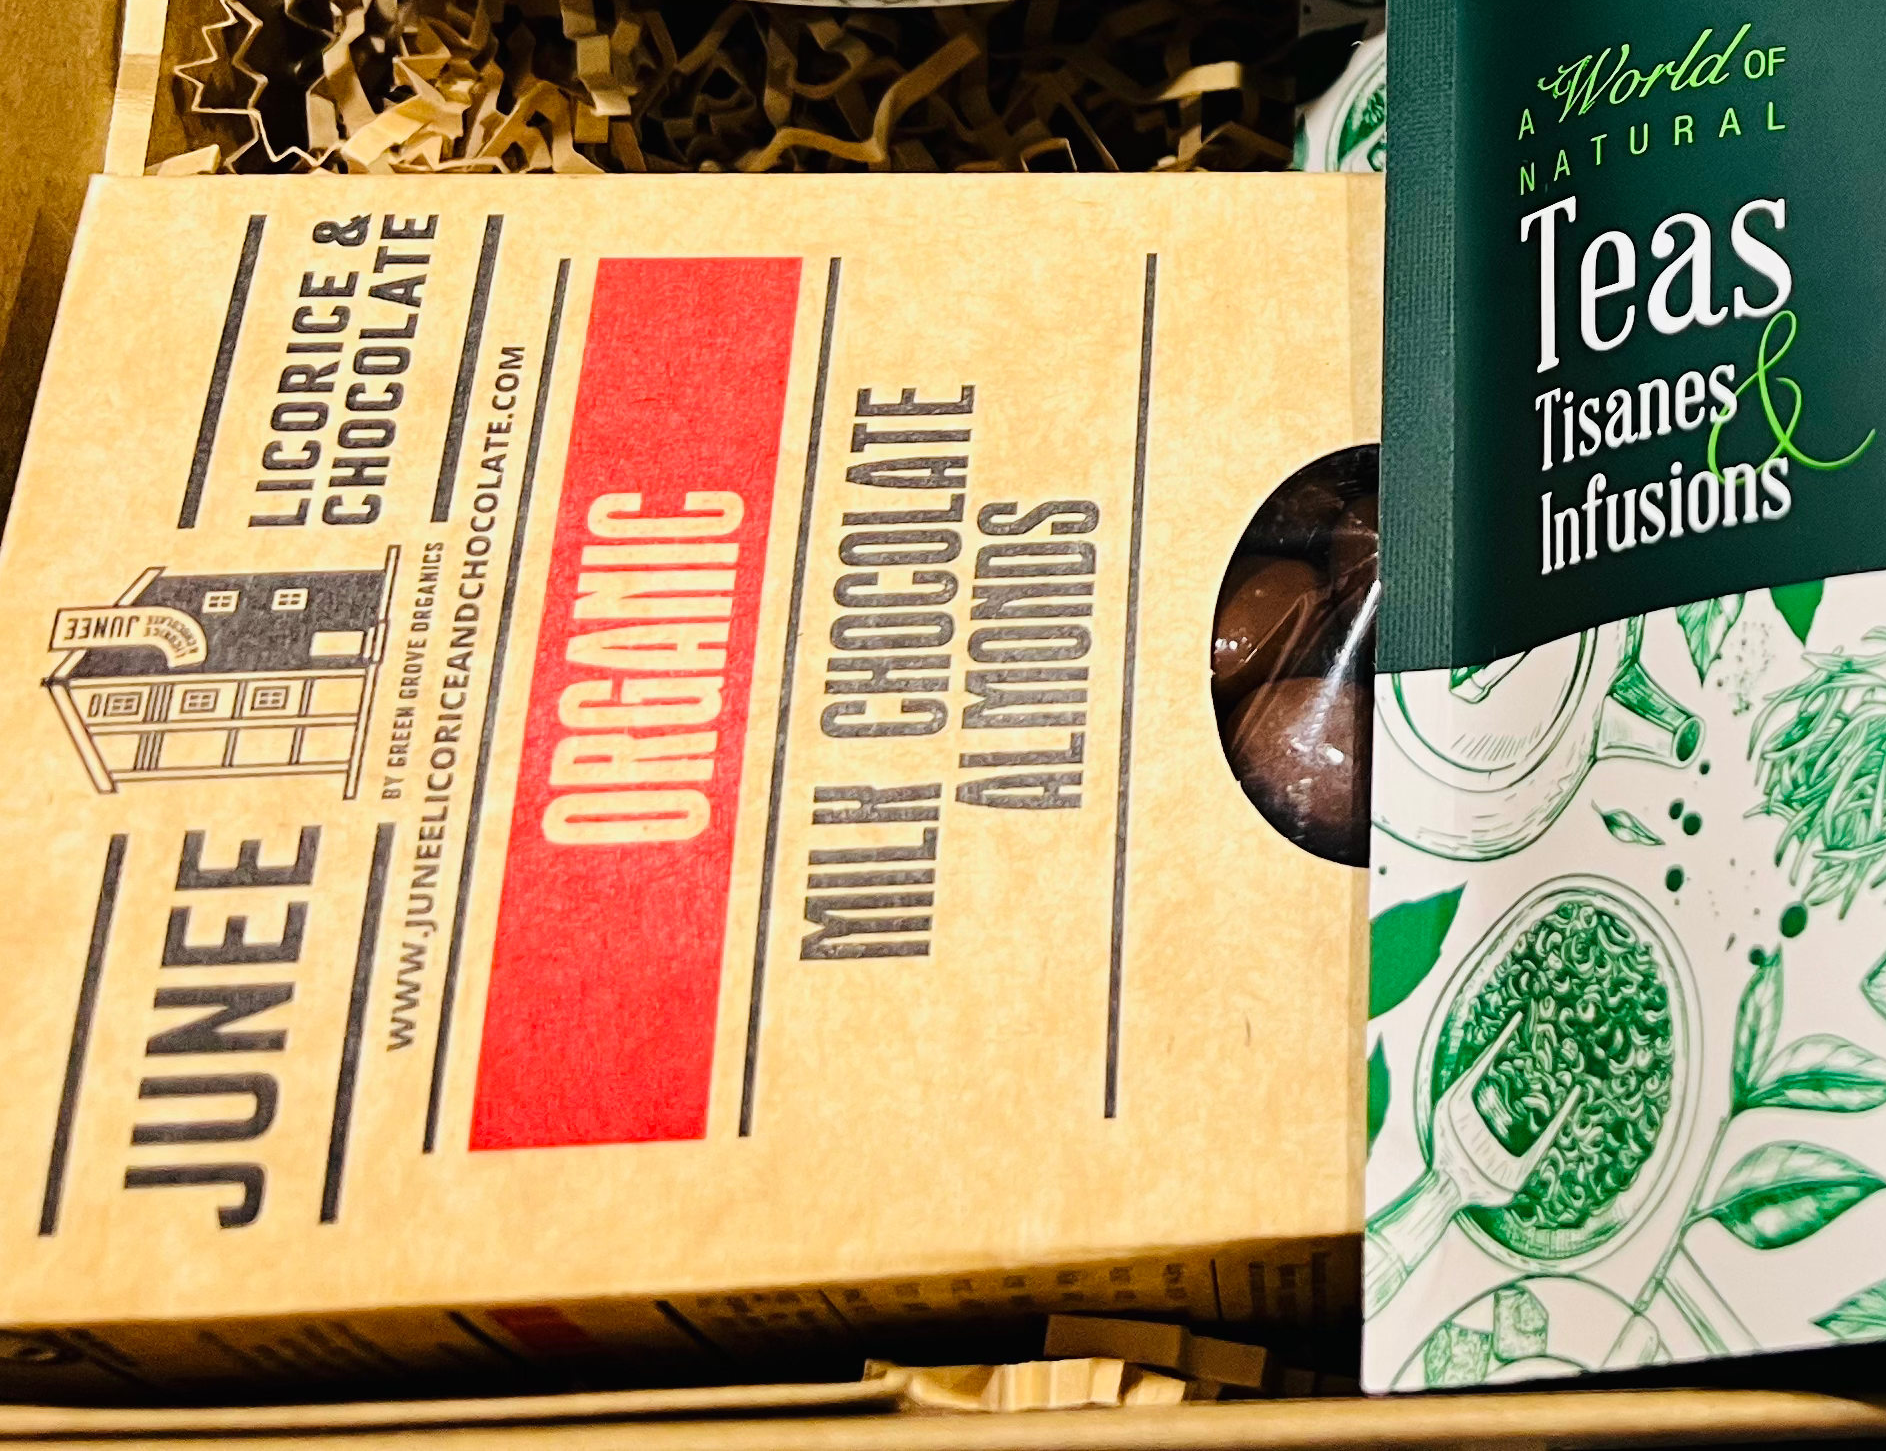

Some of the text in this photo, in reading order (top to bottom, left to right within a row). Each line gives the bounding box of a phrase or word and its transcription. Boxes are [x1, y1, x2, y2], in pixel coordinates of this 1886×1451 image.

[1517, 23, 1787, 141] A World OF
[1518, 101, 1786, 197] NATURAL
[247, 213, 372, 528] LICORICE &
[321, 213, 439, 527] CHOCOLATE
[1520, 195, 1793, 374] Teas
[1535, 310, 1876, 486] Tisanes &
[63, 615, 141, 641] JUNEE
[954, 499, 1100, 810] ALMONDS
[1541, 457, 1793, 575] Infusions
[381, 541, 445, 800] BY GREEN GROVE ORGANICS
[386, 346, 525, 1052] WWW.JUNEELICORICEANDCHOCOLATE.COM
[541, 490, 745, 846] ORGANIC
[800, 383, 976, 963] MILK CHOCOLATE
[123, 824, 322, 1230] JUNEE
